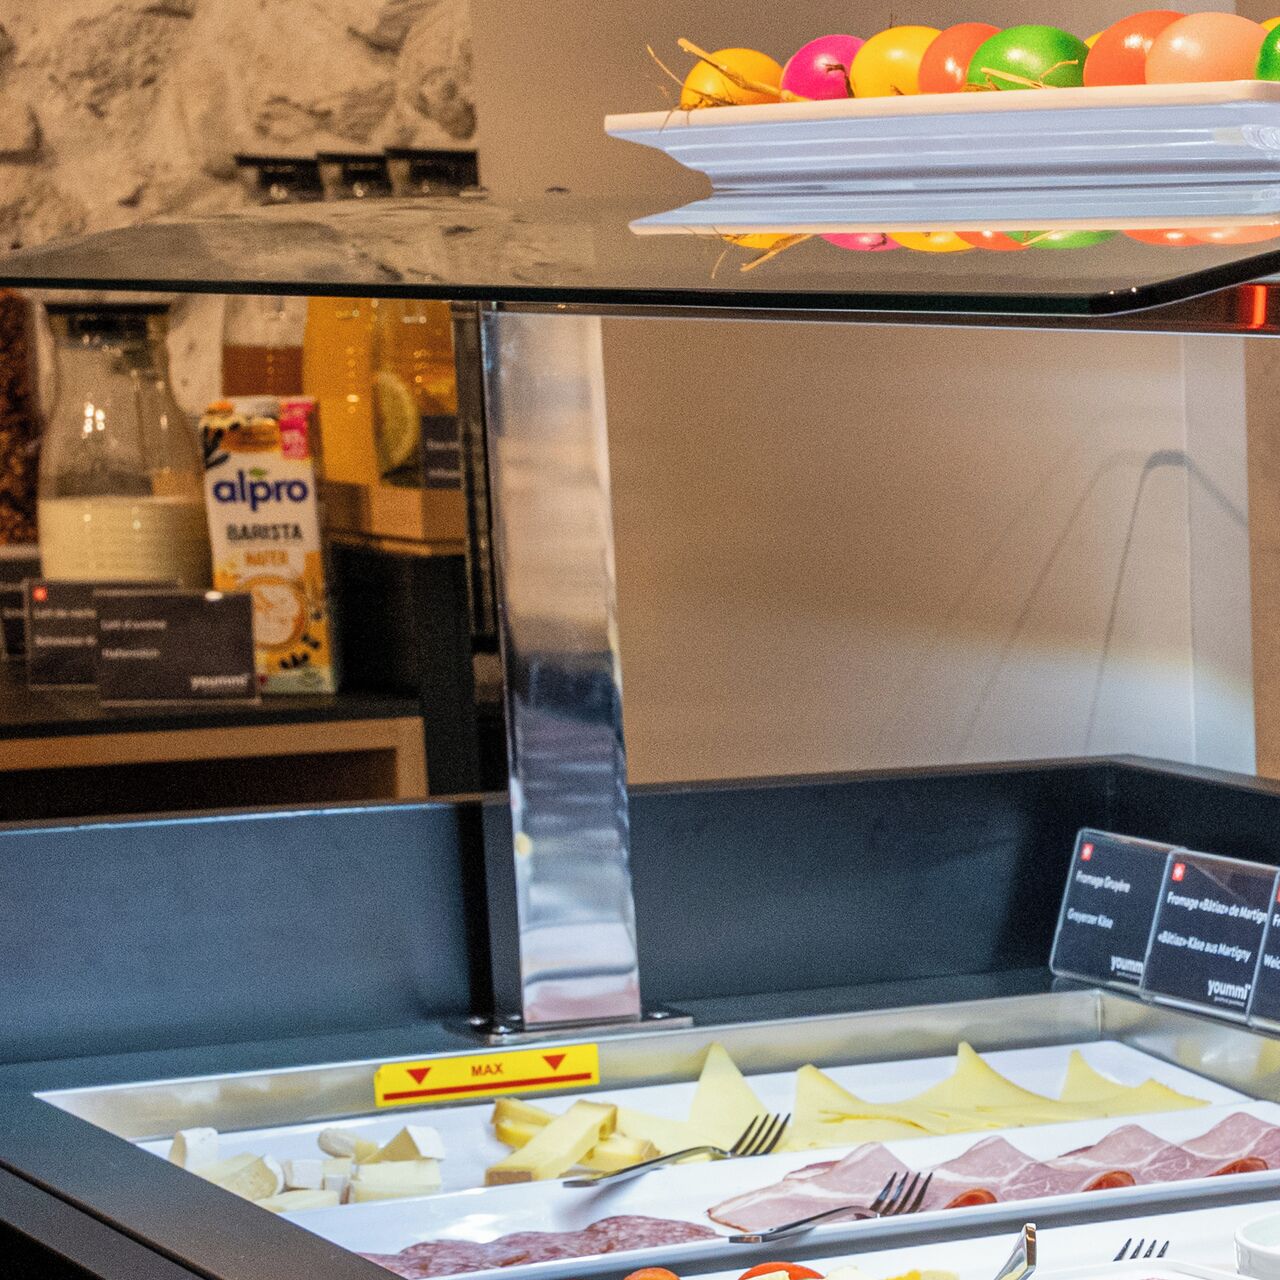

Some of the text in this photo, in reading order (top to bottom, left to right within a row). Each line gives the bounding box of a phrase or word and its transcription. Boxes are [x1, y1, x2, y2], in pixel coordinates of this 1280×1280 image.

[213, 469, 308, 512] alpro
[1076, 870, 1104, 889] Fromage
[1167, 891, 1199, 911] Fromage
[1228, 904, 1240, 917] de
[1239, 906, 1269, 925] Martign
[1204, 941, 1218, 954] aus
[1217, 943, 1252, 963] Martigny
[1111, 955, 1143, 973] youmm
[1208, 979, 1251, 1000] yoummi
[471, 1062, 503, 1077] MAX
